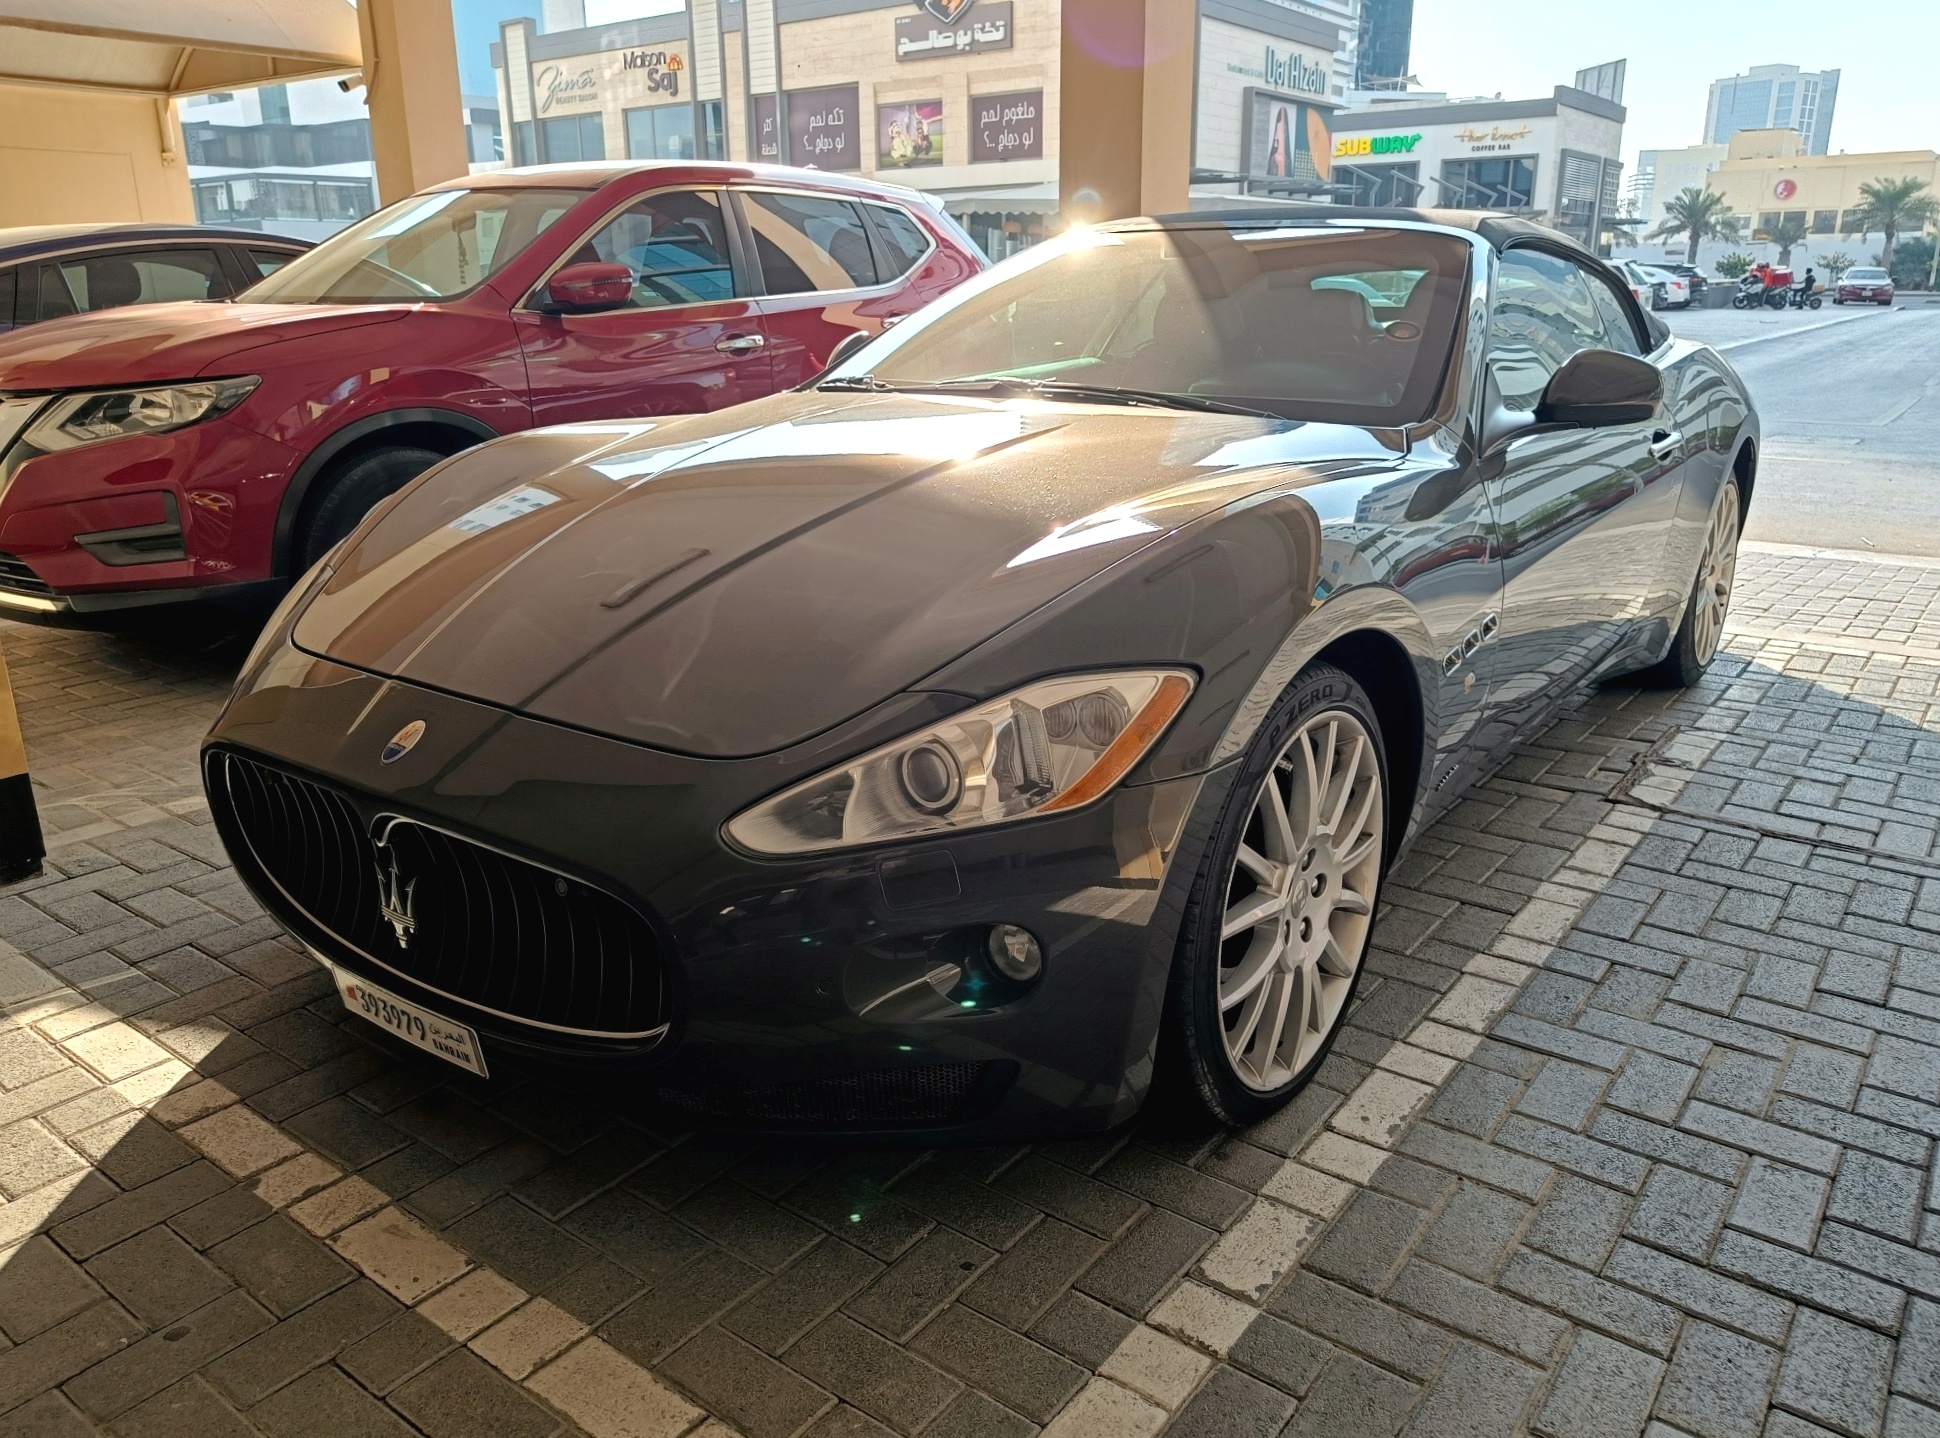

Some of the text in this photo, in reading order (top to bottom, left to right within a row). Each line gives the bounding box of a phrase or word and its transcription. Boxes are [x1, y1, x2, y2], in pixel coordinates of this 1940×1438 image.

[623, 51, 667, 71] Maison
[1265, 46, 1288, 87] Dar
[1289, 53, 1326, 95] Alzain
[647, 68, 678, 97] Saj
[809, 107, 844, 132] تكه لحم
[980, 101, 1035, 129] ملغوم لحم
[815, 133, 834, 155] دجاج
[835, 132, 845, 154] لو
[998, 129, 1020, 153] دجاج
[1022, 126, 1034, 150] لو
[1334, 132, 1422, 158] SUBWAY
[1498, 143, 1511, 151] BAR
[1269, 683, 1334, 751] P ZERO
[356, 985, 426, 1041] 393979
[432, 1037, 472, 1065] BAHRAIN
